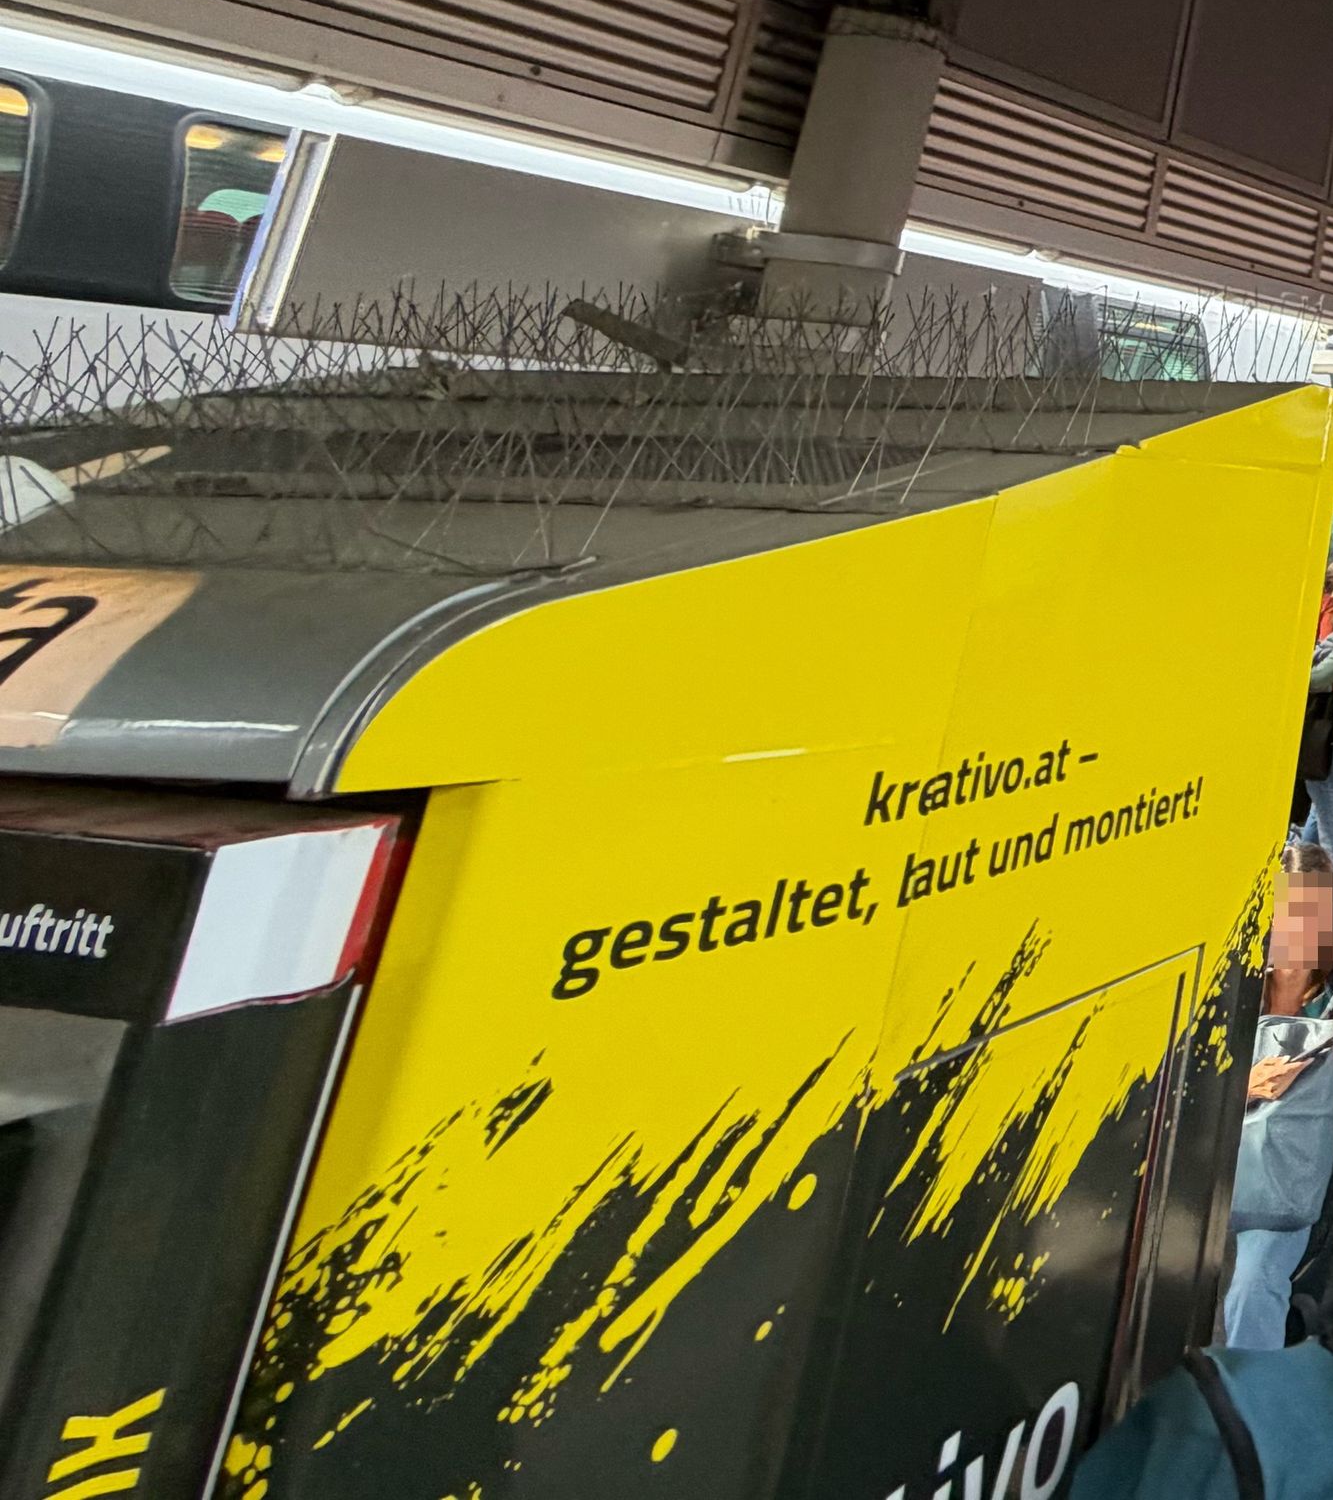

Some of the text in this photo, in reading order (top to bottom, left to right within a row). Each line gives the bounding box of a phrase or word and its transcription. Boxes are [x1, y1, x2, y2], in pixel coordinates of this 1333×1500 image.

[863, 739, 1071, 826] krativo.at
[0, 903, 115, 959] uftritt
[551, 776, 1205, 1001] gestaltet, laut und montiert!
